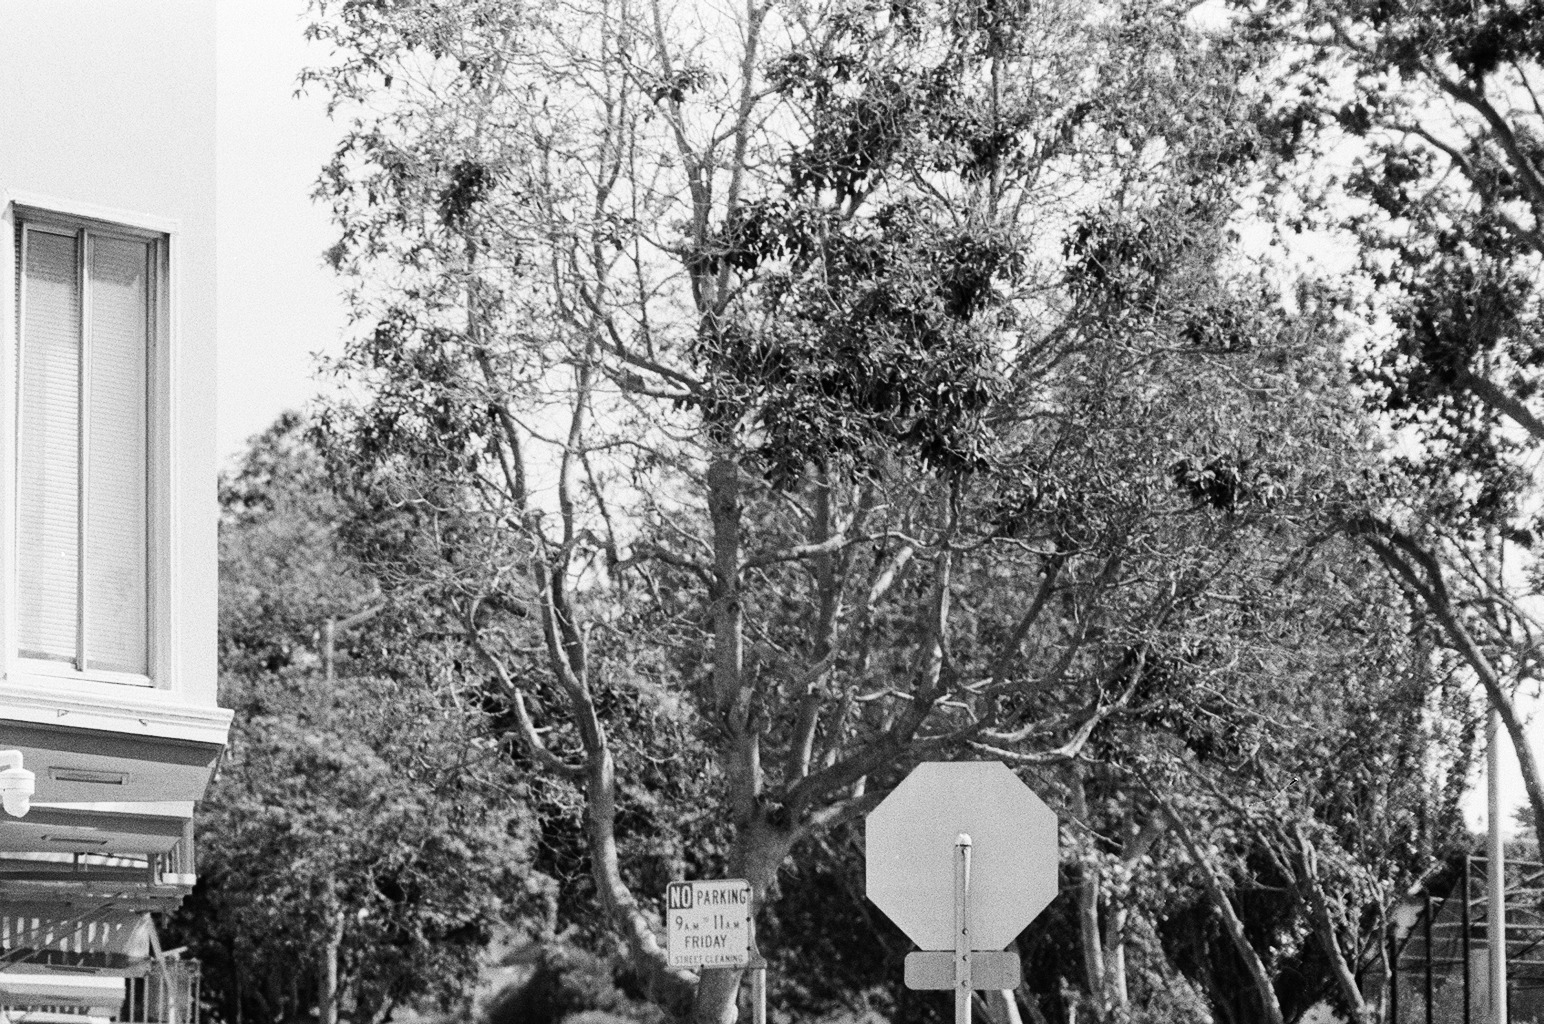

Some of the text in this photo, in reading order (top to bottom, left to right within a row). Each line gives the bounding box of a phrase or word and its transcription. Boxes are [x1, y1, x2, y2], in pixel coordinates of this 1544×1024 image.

[670, 885, 746, 908] NO PARKING
[684, 934, 727, 948] FRIDAY
